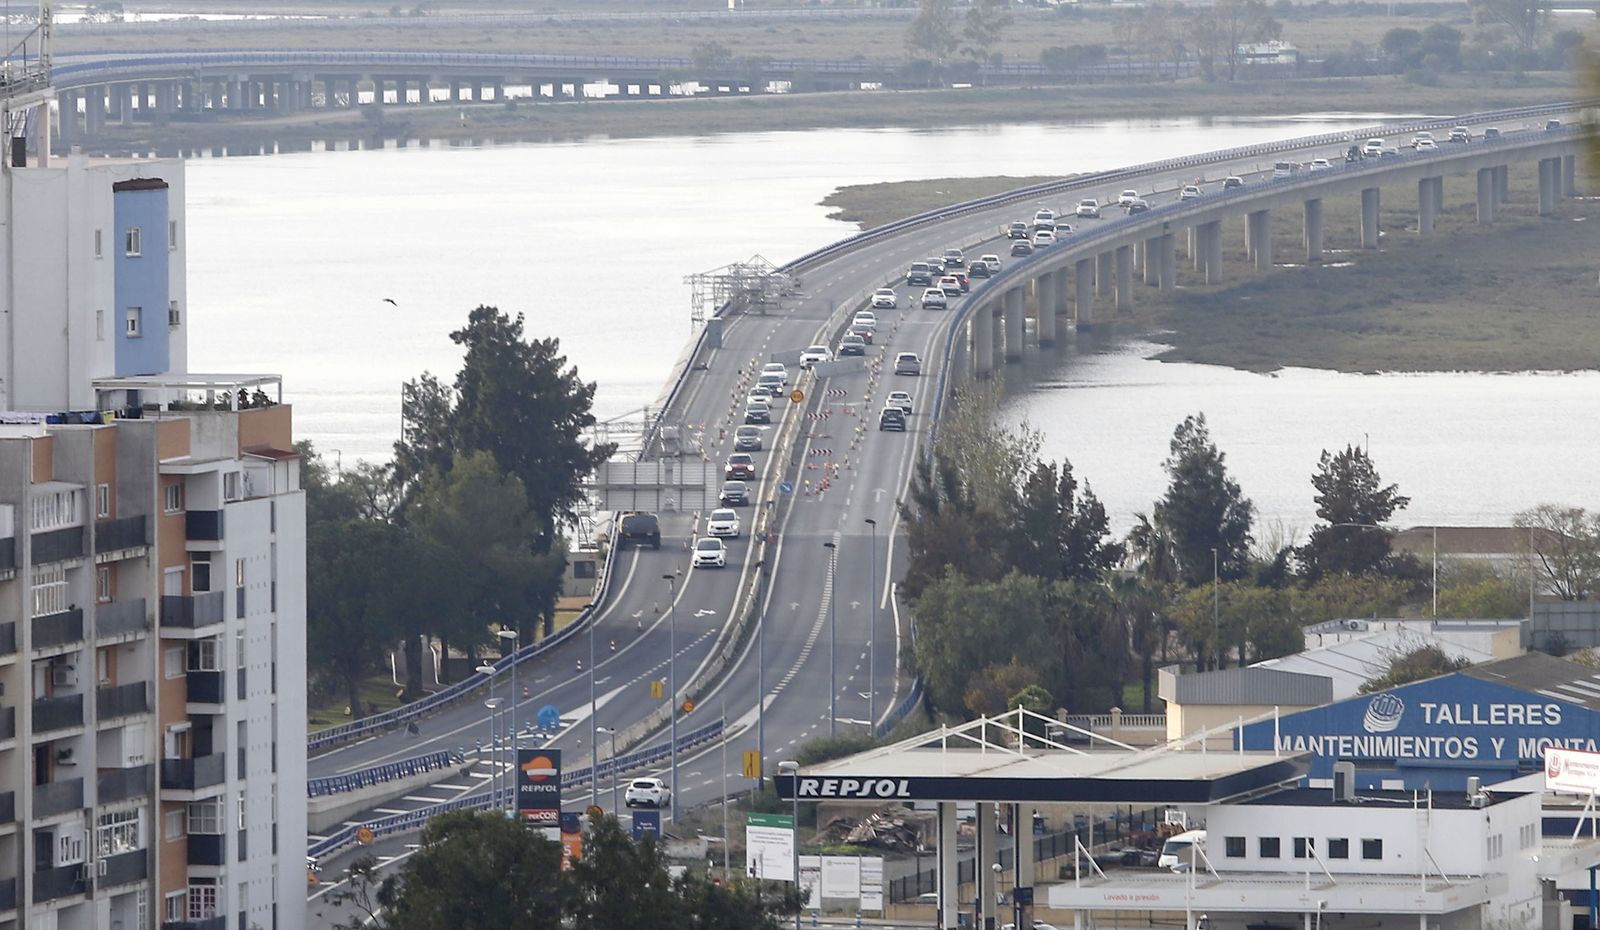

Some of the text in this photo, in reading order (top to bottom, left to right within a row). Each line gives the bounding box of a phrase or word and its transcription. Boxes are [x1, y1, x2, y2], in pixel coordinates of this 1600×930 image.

[1420, 702, 1562, 726] TALLERES
[1274, 735, 1479, 759] MANTENIMIENTOS
[1490, 737, 1506, 759] Y
[520, 784, 558, 793] REPSOL
[798, 778, 911, 798] REPSOL
